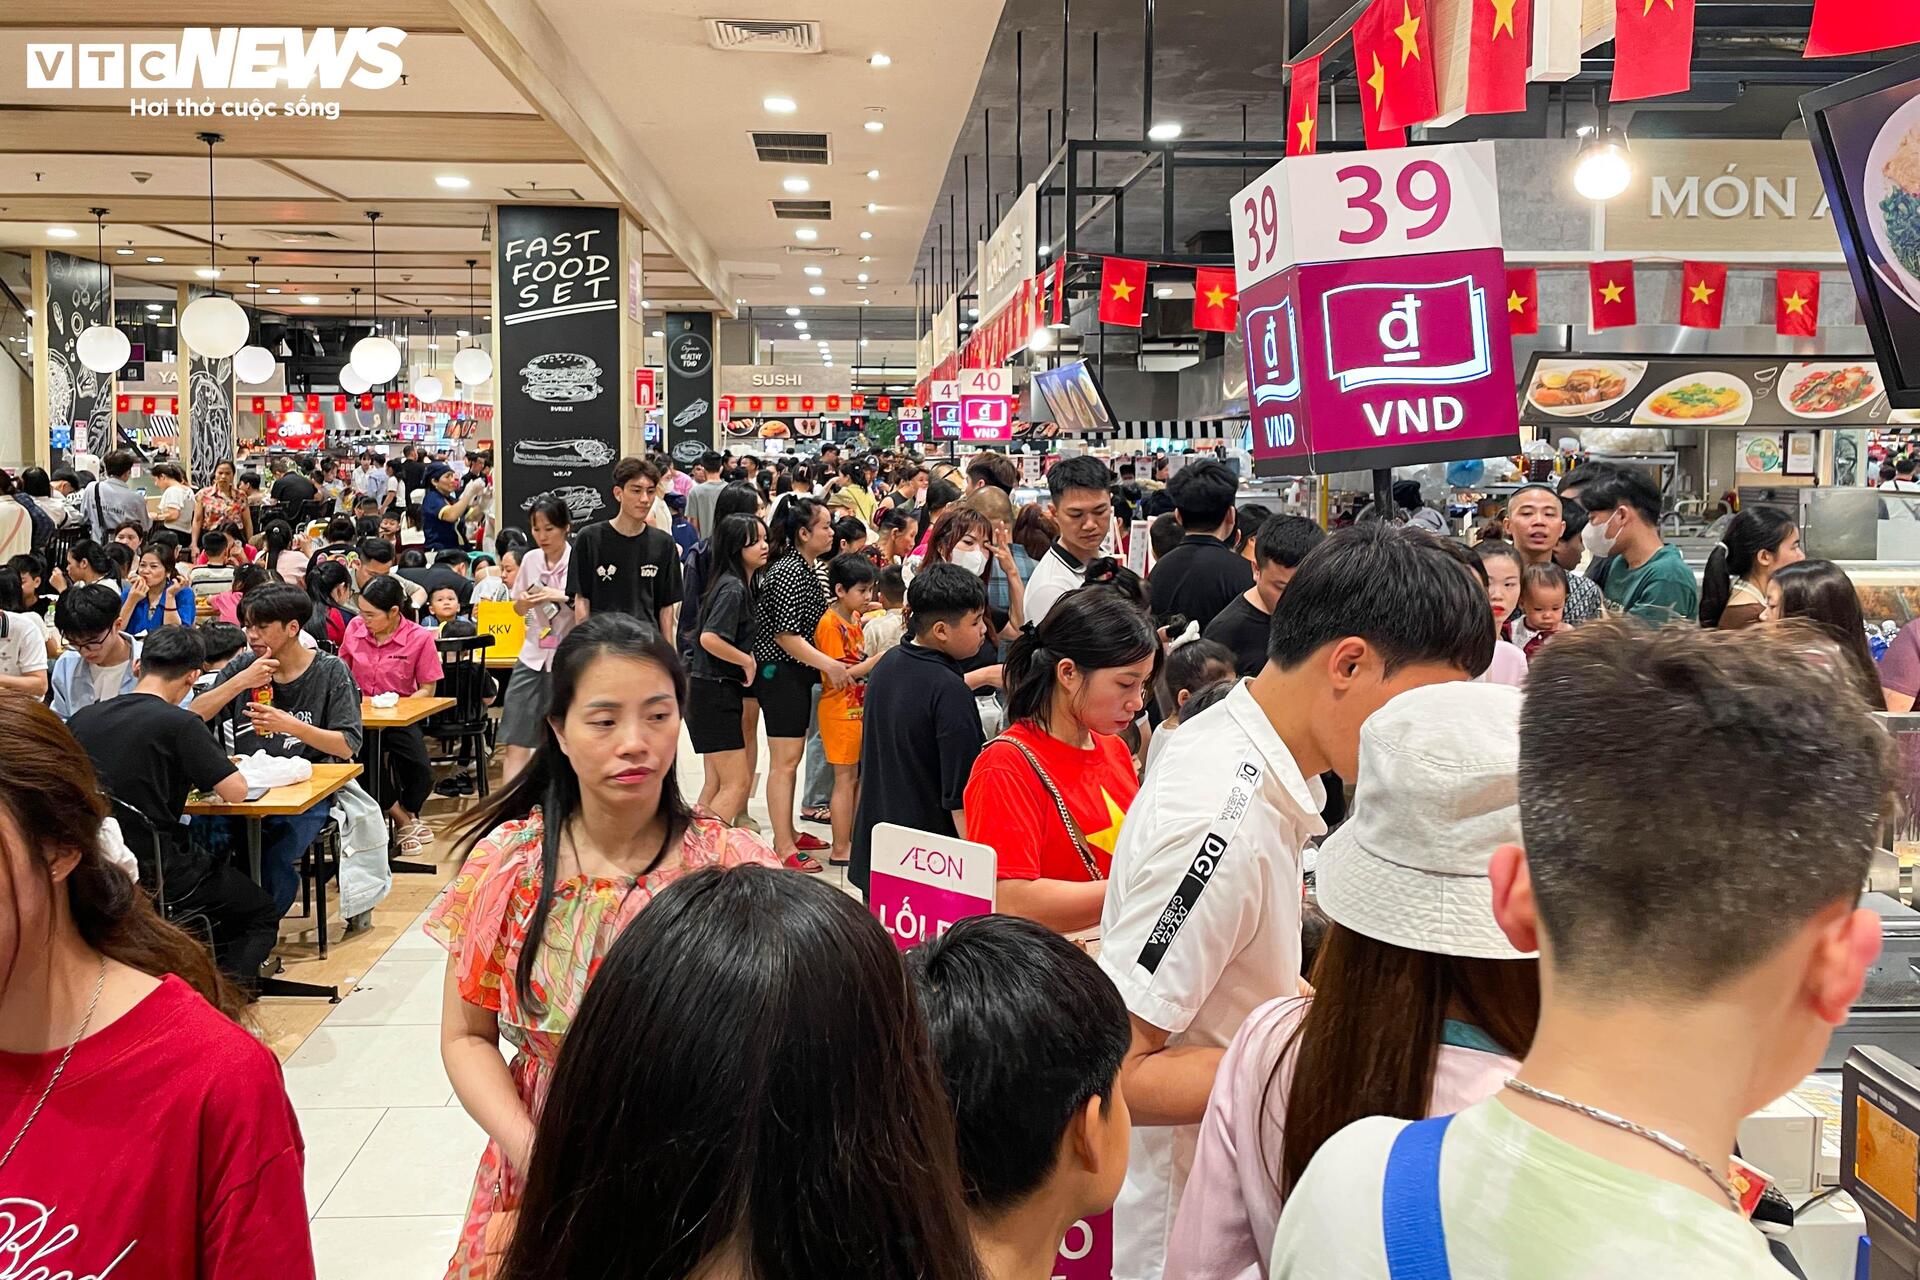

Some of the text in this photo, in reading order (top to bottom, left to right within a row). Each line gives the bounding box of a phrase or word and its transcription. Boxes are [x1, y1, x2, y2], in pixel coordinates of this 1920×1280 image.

[1335, 159, 1452, 245] 39
[1651, 163, 1798, 219] MÓN
[1244, 184, 1278, 272] 39
[505, 229, 600, 262] FAST
[512, 255, 610, 286] FOOD
[518, 276, 611, 308] SET
[752, 373, 802, 387] SUSHI
[972, 372, 1000, 391] 40
[973, 428, 999, 438] VND
[1264, 413, 1295, 448] VND
[1363, 396, 1463, 437] VND
[488, 624, 512, 634] KKV
[1194, 837, 1225, 878] DG
